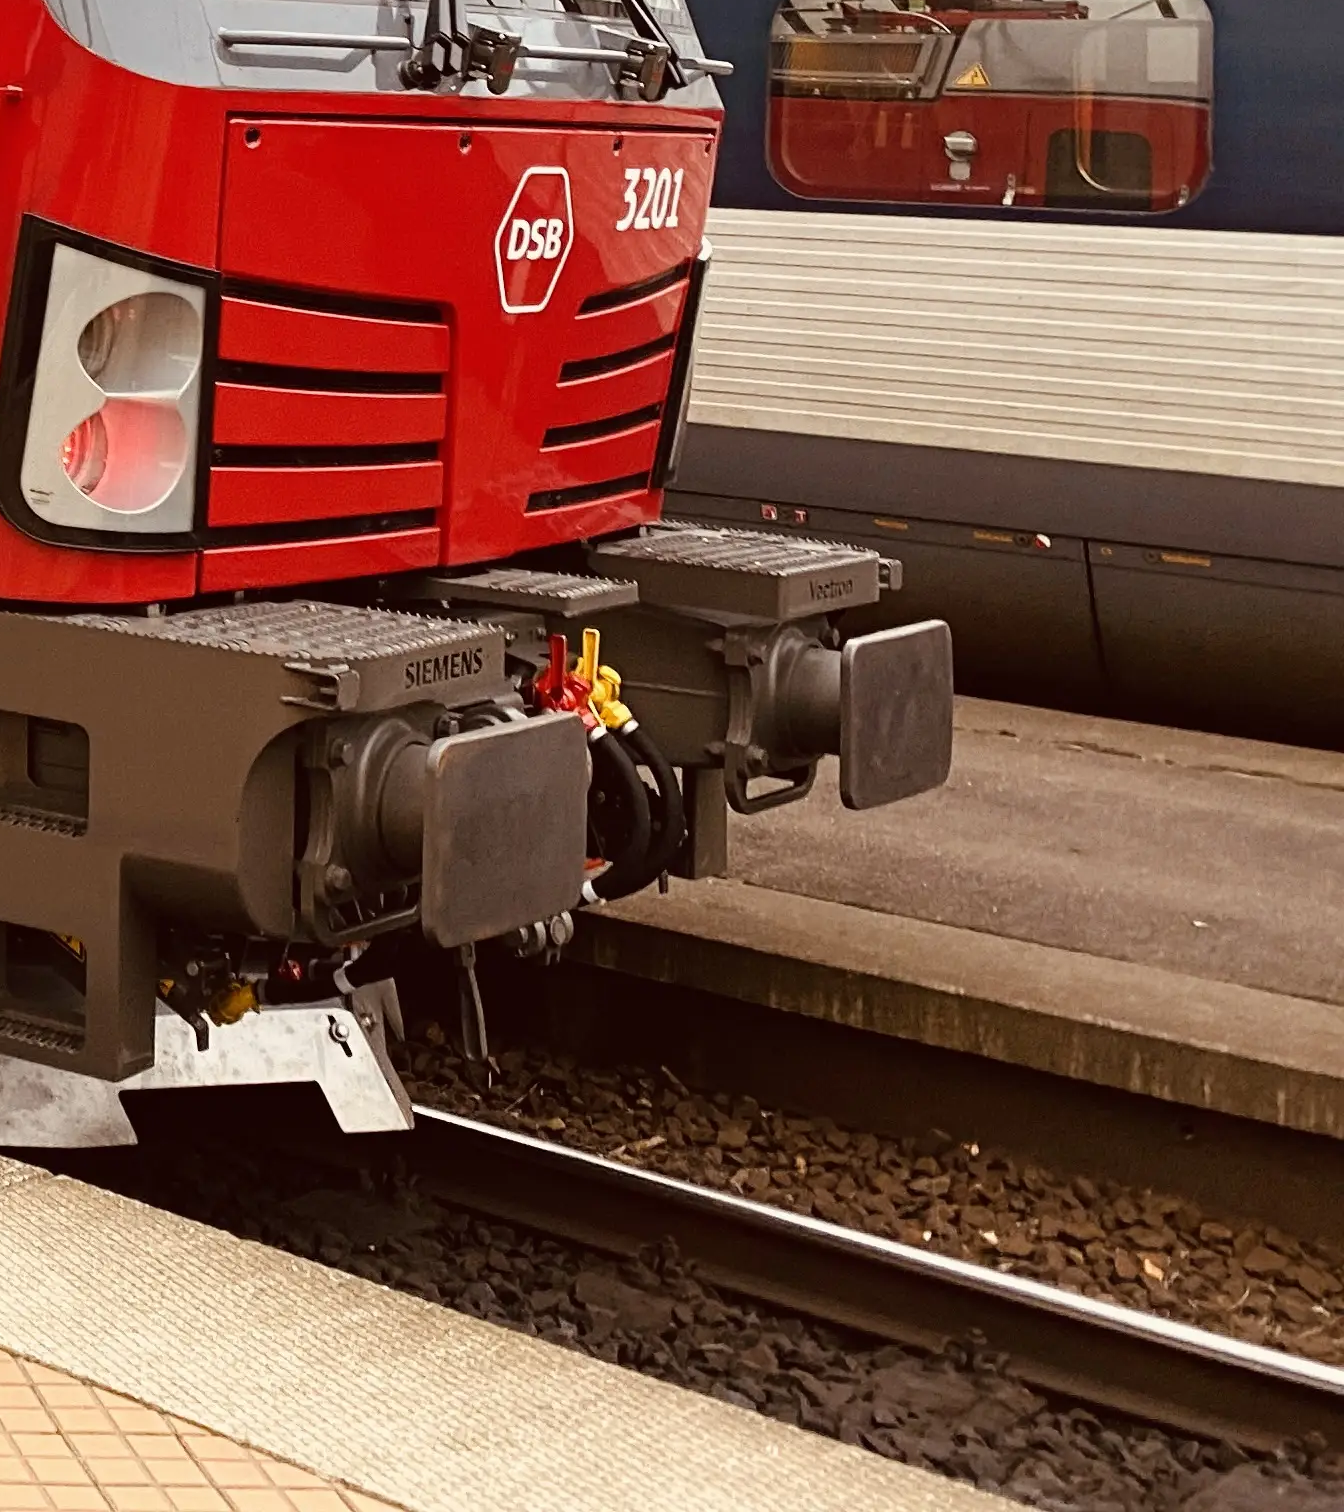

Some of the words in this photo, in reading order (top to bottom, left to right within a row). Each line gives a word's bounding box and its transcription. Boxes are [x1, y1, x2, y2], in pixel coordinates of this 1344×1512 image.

[615, 167, 684, 232] 3201
[506, 218, 564, 261] DSB
[404, 647, 483, 689] SIEMENS
